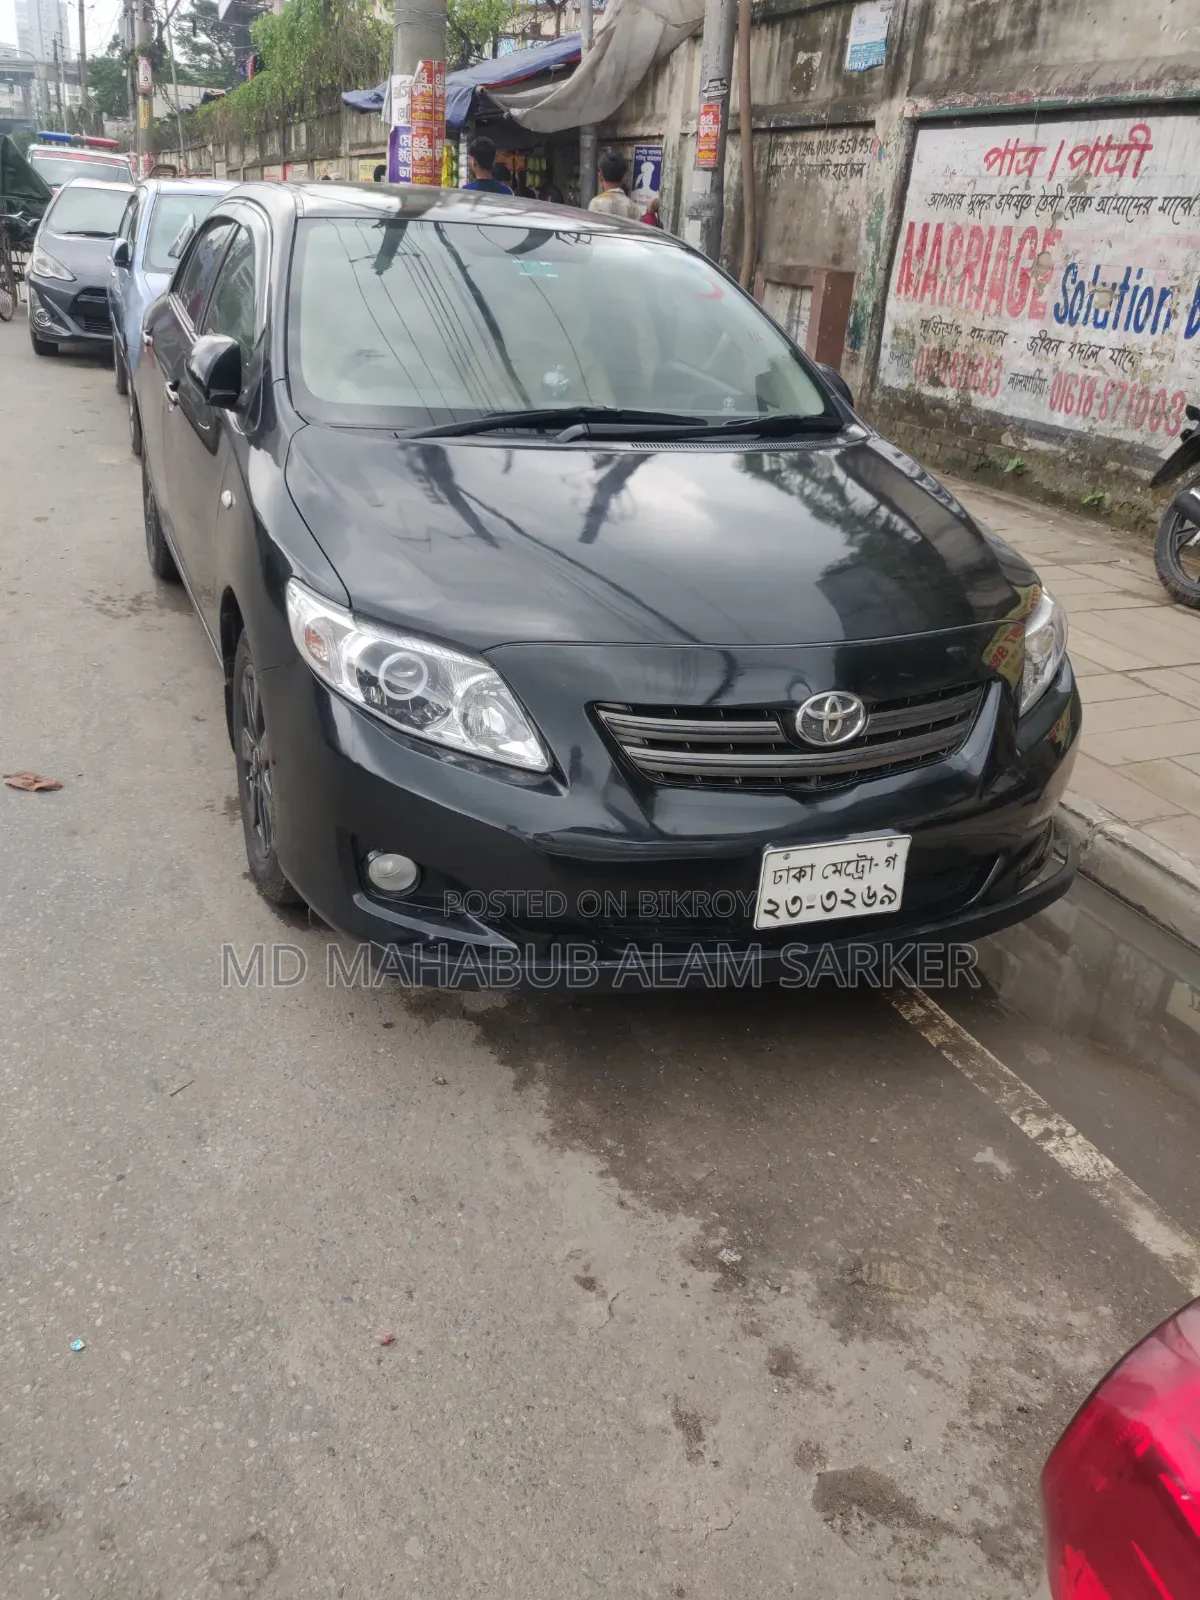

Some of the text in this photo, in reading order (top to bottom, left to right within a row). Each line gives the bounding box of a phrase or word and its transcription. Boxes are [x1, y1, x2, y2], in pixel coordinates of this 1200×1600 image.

[1095, 193, 1158, 223] আমাদের
[896, 221, 1063, 320] MARRIAGE
[1053, 262, 1173, 336] Solution
[1027, 329, 1065, 356] জীবন
[773, 863, 816, 884] ঢাকা
[763, 883, 897, 919] ২৩-৩২৬৯
